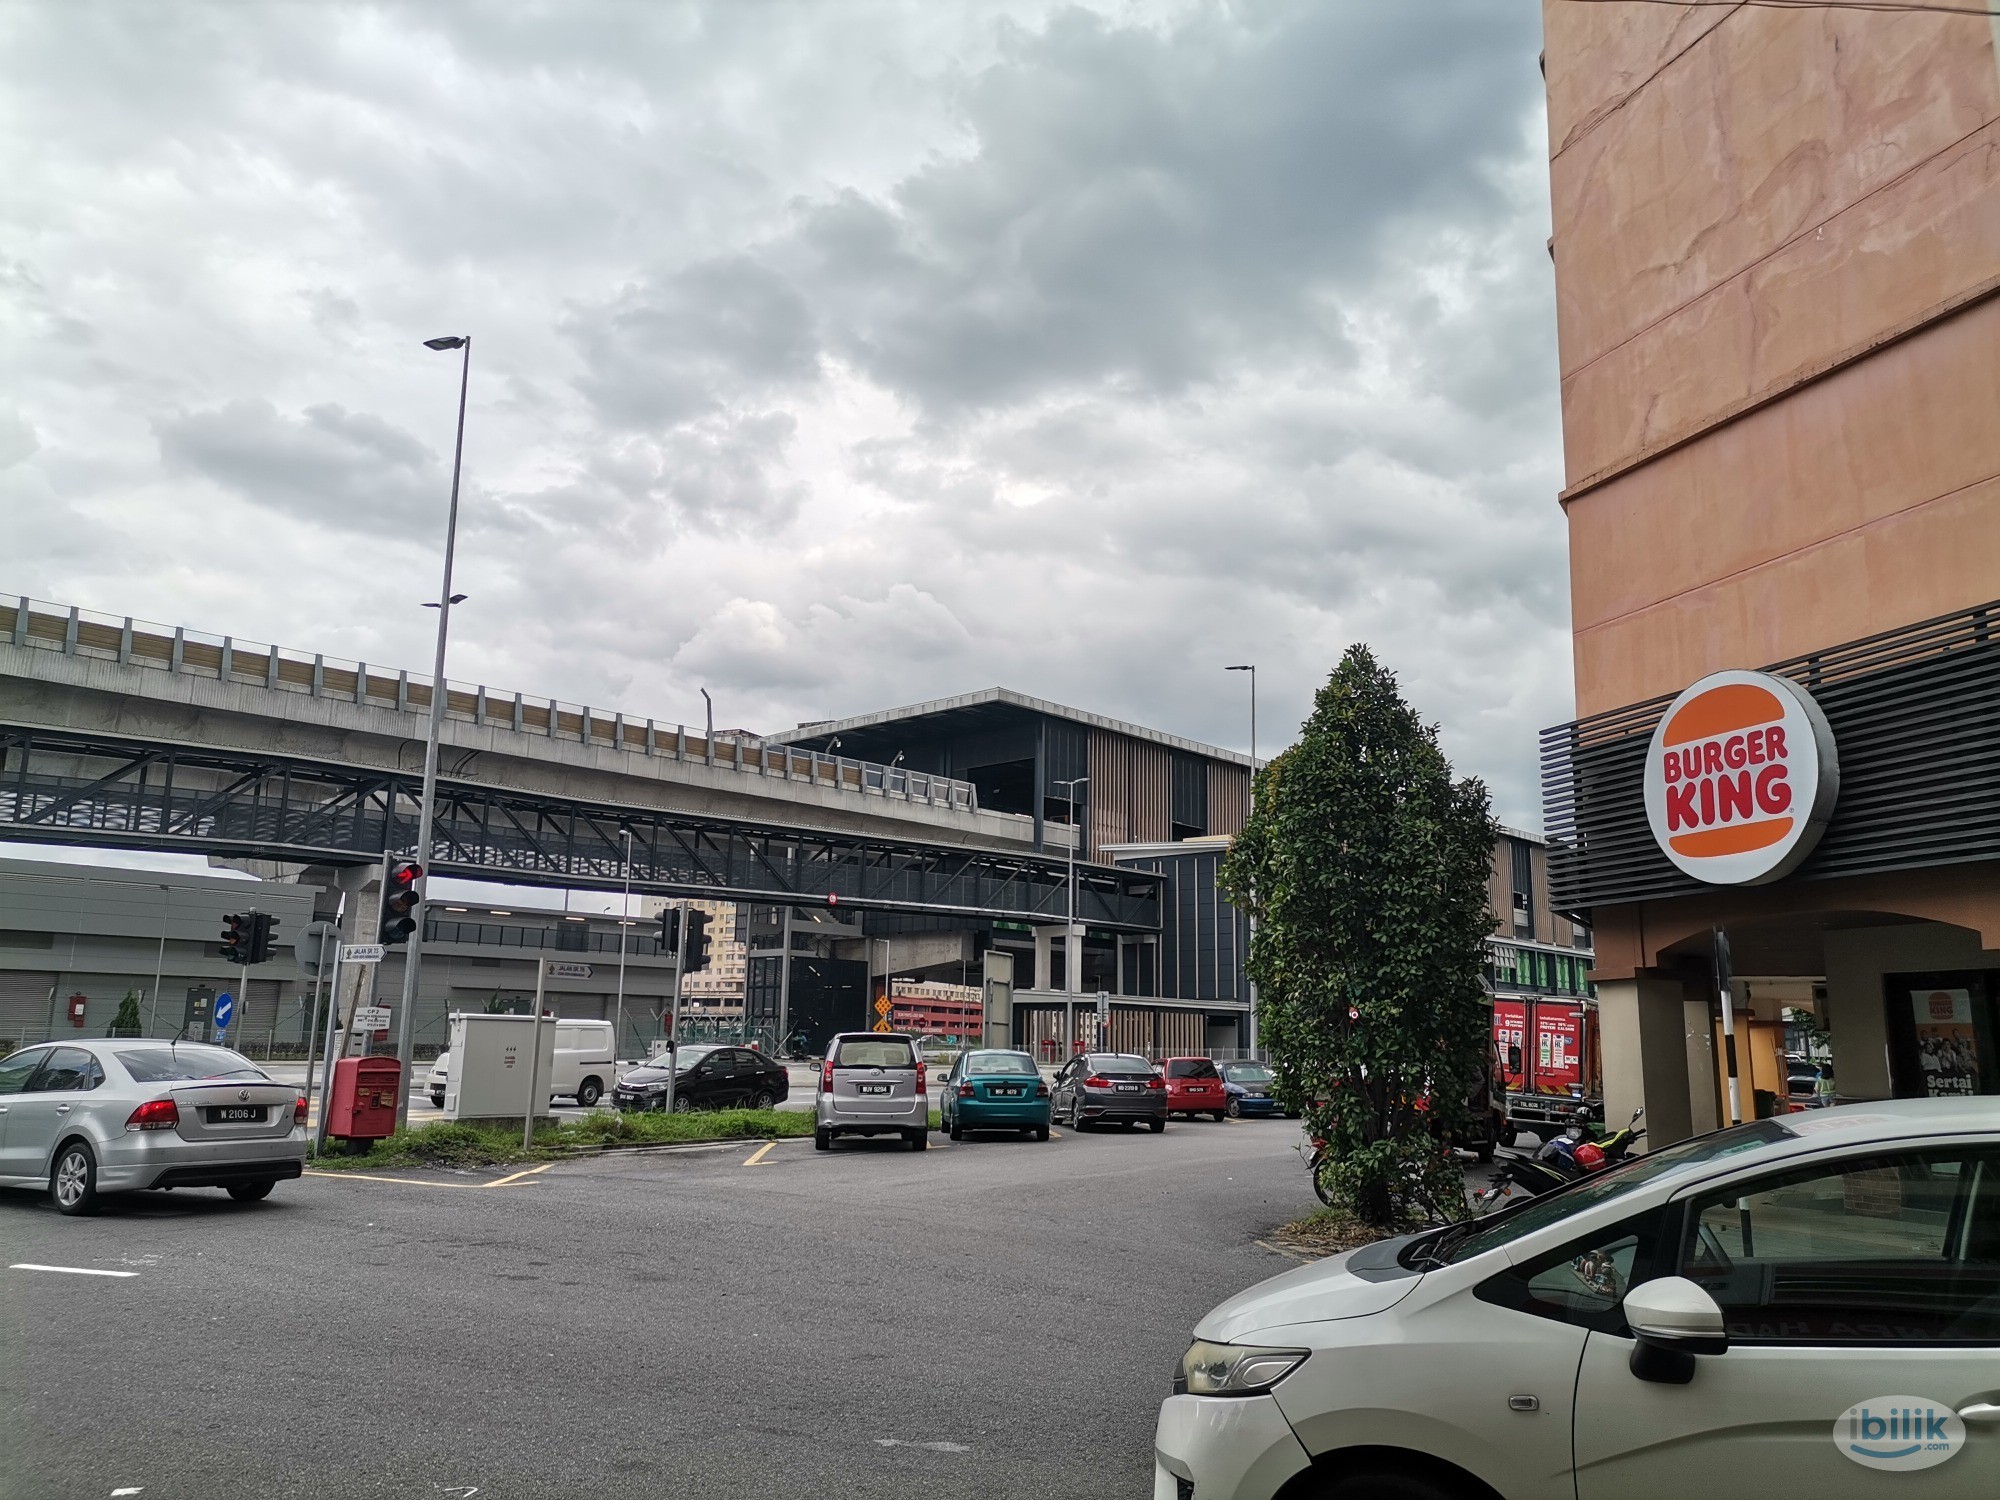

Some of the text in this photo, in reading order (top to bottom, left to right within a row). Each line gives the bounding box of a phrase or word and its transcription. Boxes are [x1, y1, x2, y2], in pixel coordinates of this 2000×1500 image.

[1664, 726, 1788, 784] BURGER
[1666, 764, 1792, 831] KING
[1930, 1006, 1954, 1015] KING
[1926, 1074, 1973, 1089] Sertai
[220, 1109, 257, 1119] W 2106 J
